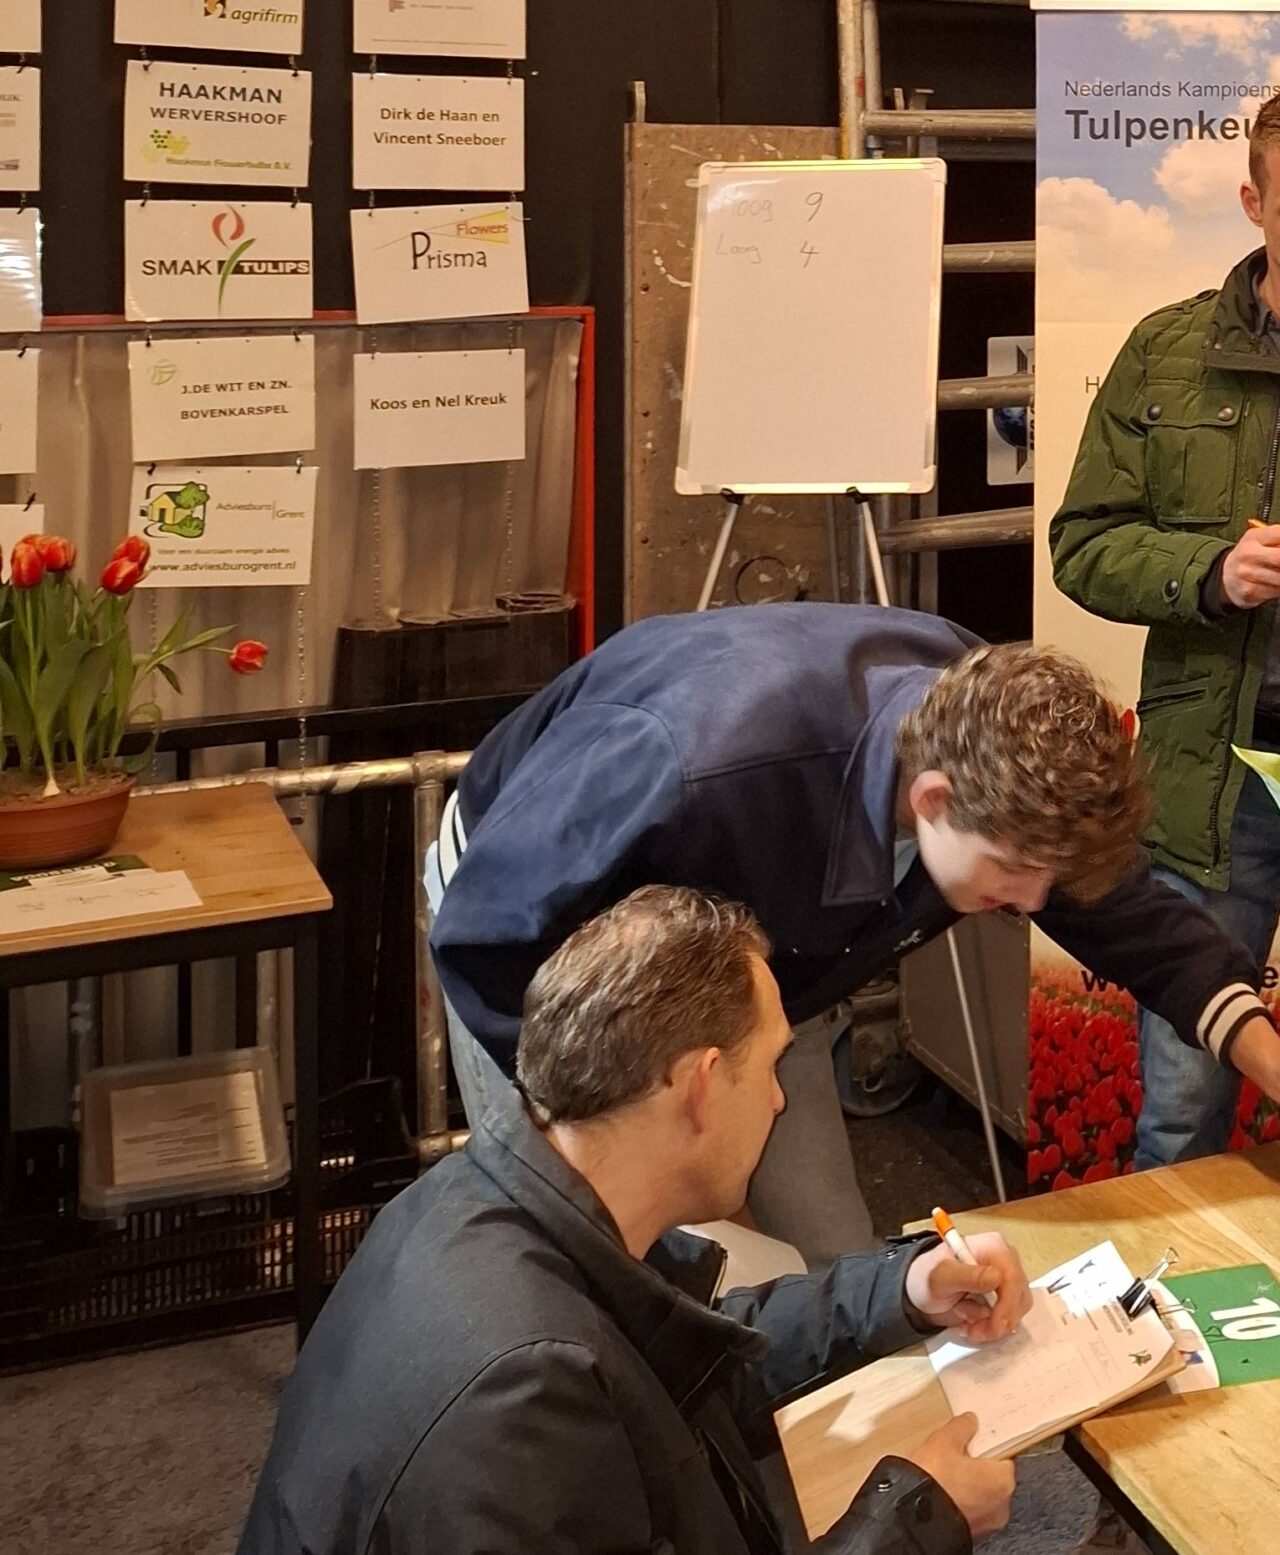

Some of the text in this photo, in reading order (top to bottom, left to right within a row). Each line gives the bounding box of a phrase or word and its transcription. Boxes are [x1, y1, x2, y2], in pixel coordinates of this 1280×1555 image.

[231, 8, 298, 24] agrifirm
[159, 81, 283, 104] HAAKMAN
[1064, 80, 1171, 98] Nederlands
[150, 106, 288, 126] WERVERSHOOF
[380, 107, 500, 123] Dirk de Haan en
[373, 131, 507, 147] Vincent Sneeboer
[805, 191, 824, 222] 9
[456, 222, 509, 236] Flowers
[410, 230, 488, 271] Prisma
[799, 240, 820, 269] 4
[142, 259, 310, 276] SMAK TULIPS
[215, 383, 243, 394] WIT
[247, 381, 267, 393] EN
[270, 380, 293, 392] ZN.
[370, 393, 507, 411] Koos en Nel Kreuk
[180, 405, 290, 420] BOVENKARSPEL
[215, 502, 272, 512] Adviesburo
[276, 508, 306, 519] Grent
[149, 561, 297, 573] www.adviesburogrent.nl
